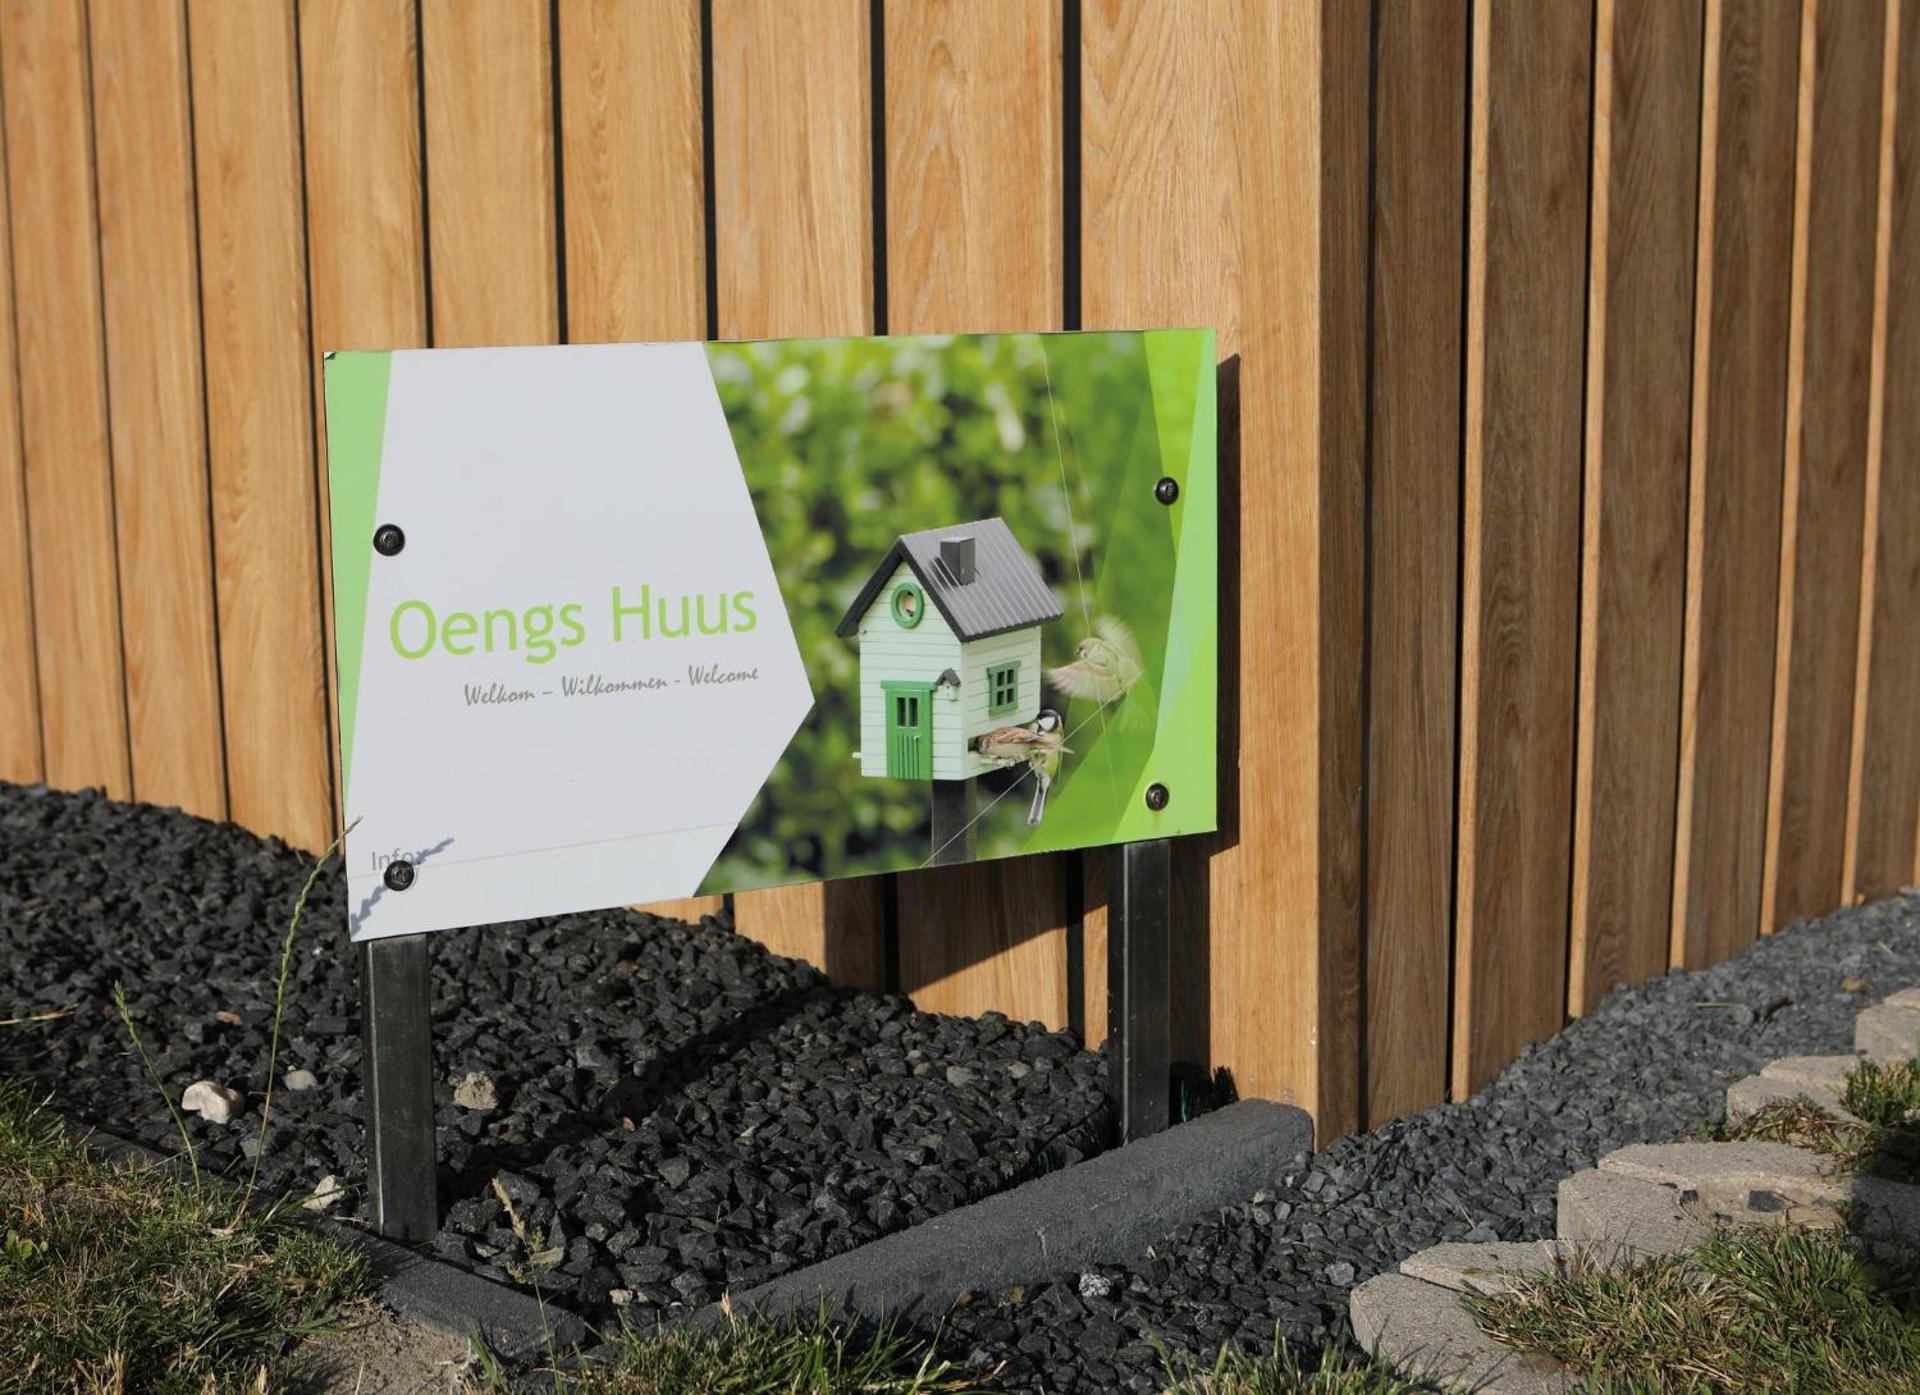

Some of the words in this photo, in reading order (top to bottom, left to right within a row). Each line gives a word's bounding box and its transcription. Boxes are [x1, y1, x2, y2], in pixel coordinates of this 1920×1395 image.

[389, 599, 587, 667] Oengs
[610, 582, 759, 643] Huus
[464, 683, 536, 707] Welkom
[561, 673, 668, 697] Wilkommen
[687, 663, 759, 686] Welcome
